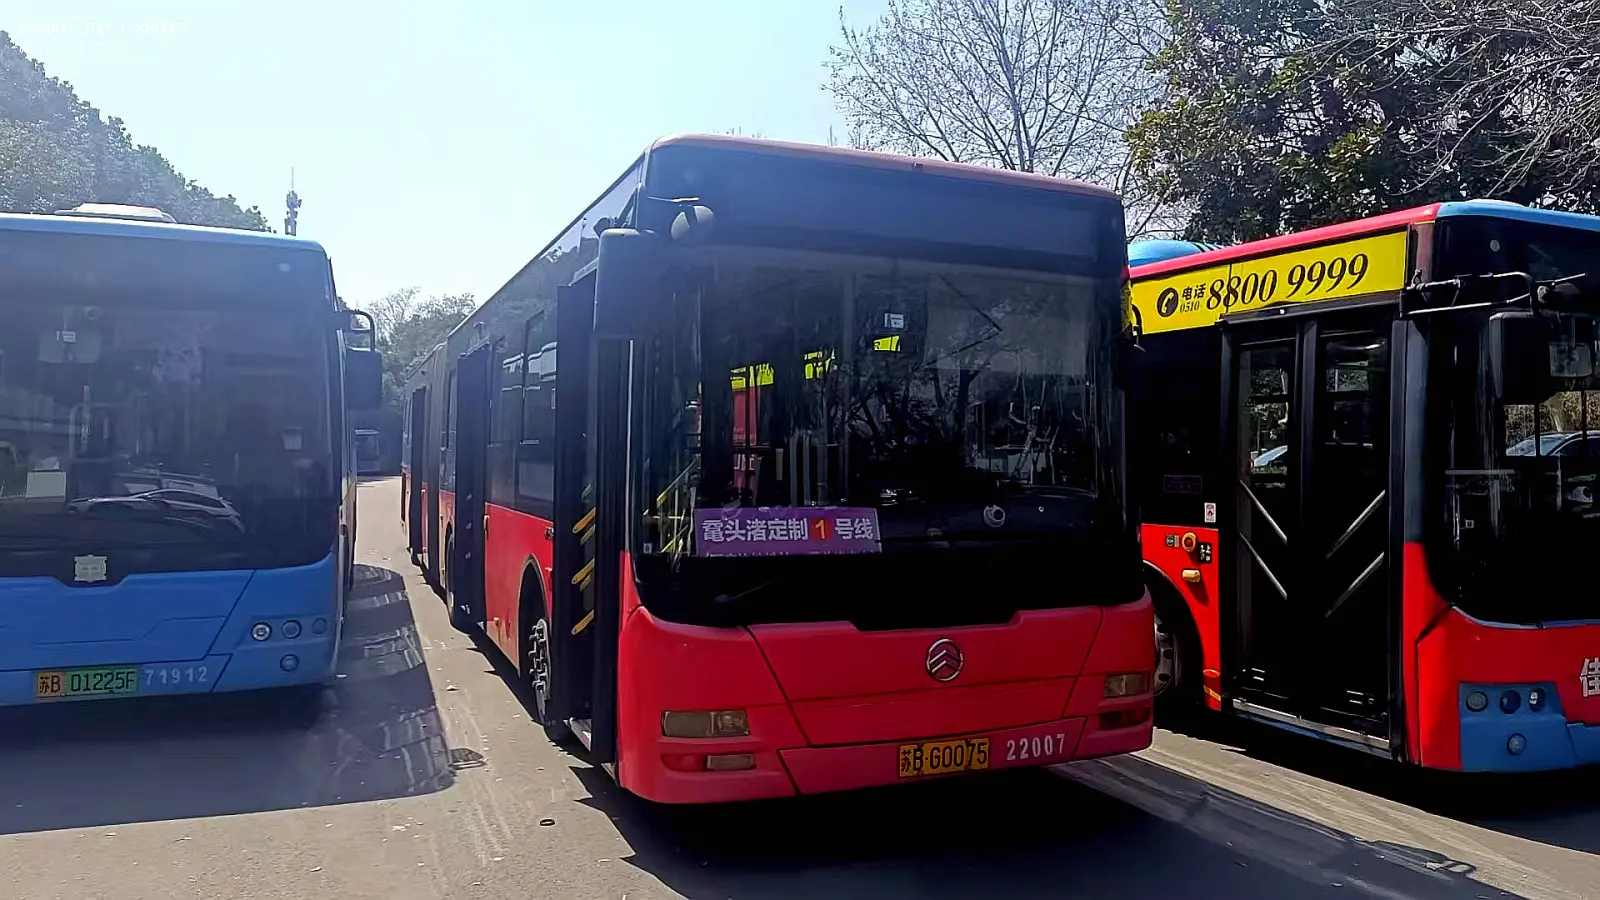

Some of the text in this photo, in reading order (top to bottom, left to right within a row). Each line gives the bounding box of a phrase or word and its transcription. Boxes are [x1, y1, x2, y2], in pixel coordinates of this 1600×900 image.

[1181, 253, 1369, 310] 电话 8800 9999
[1179, 301, 1200, 313] 0510
[144, 666, 208, 685] 71912
[1006, 733, 1066, 761] 22007
